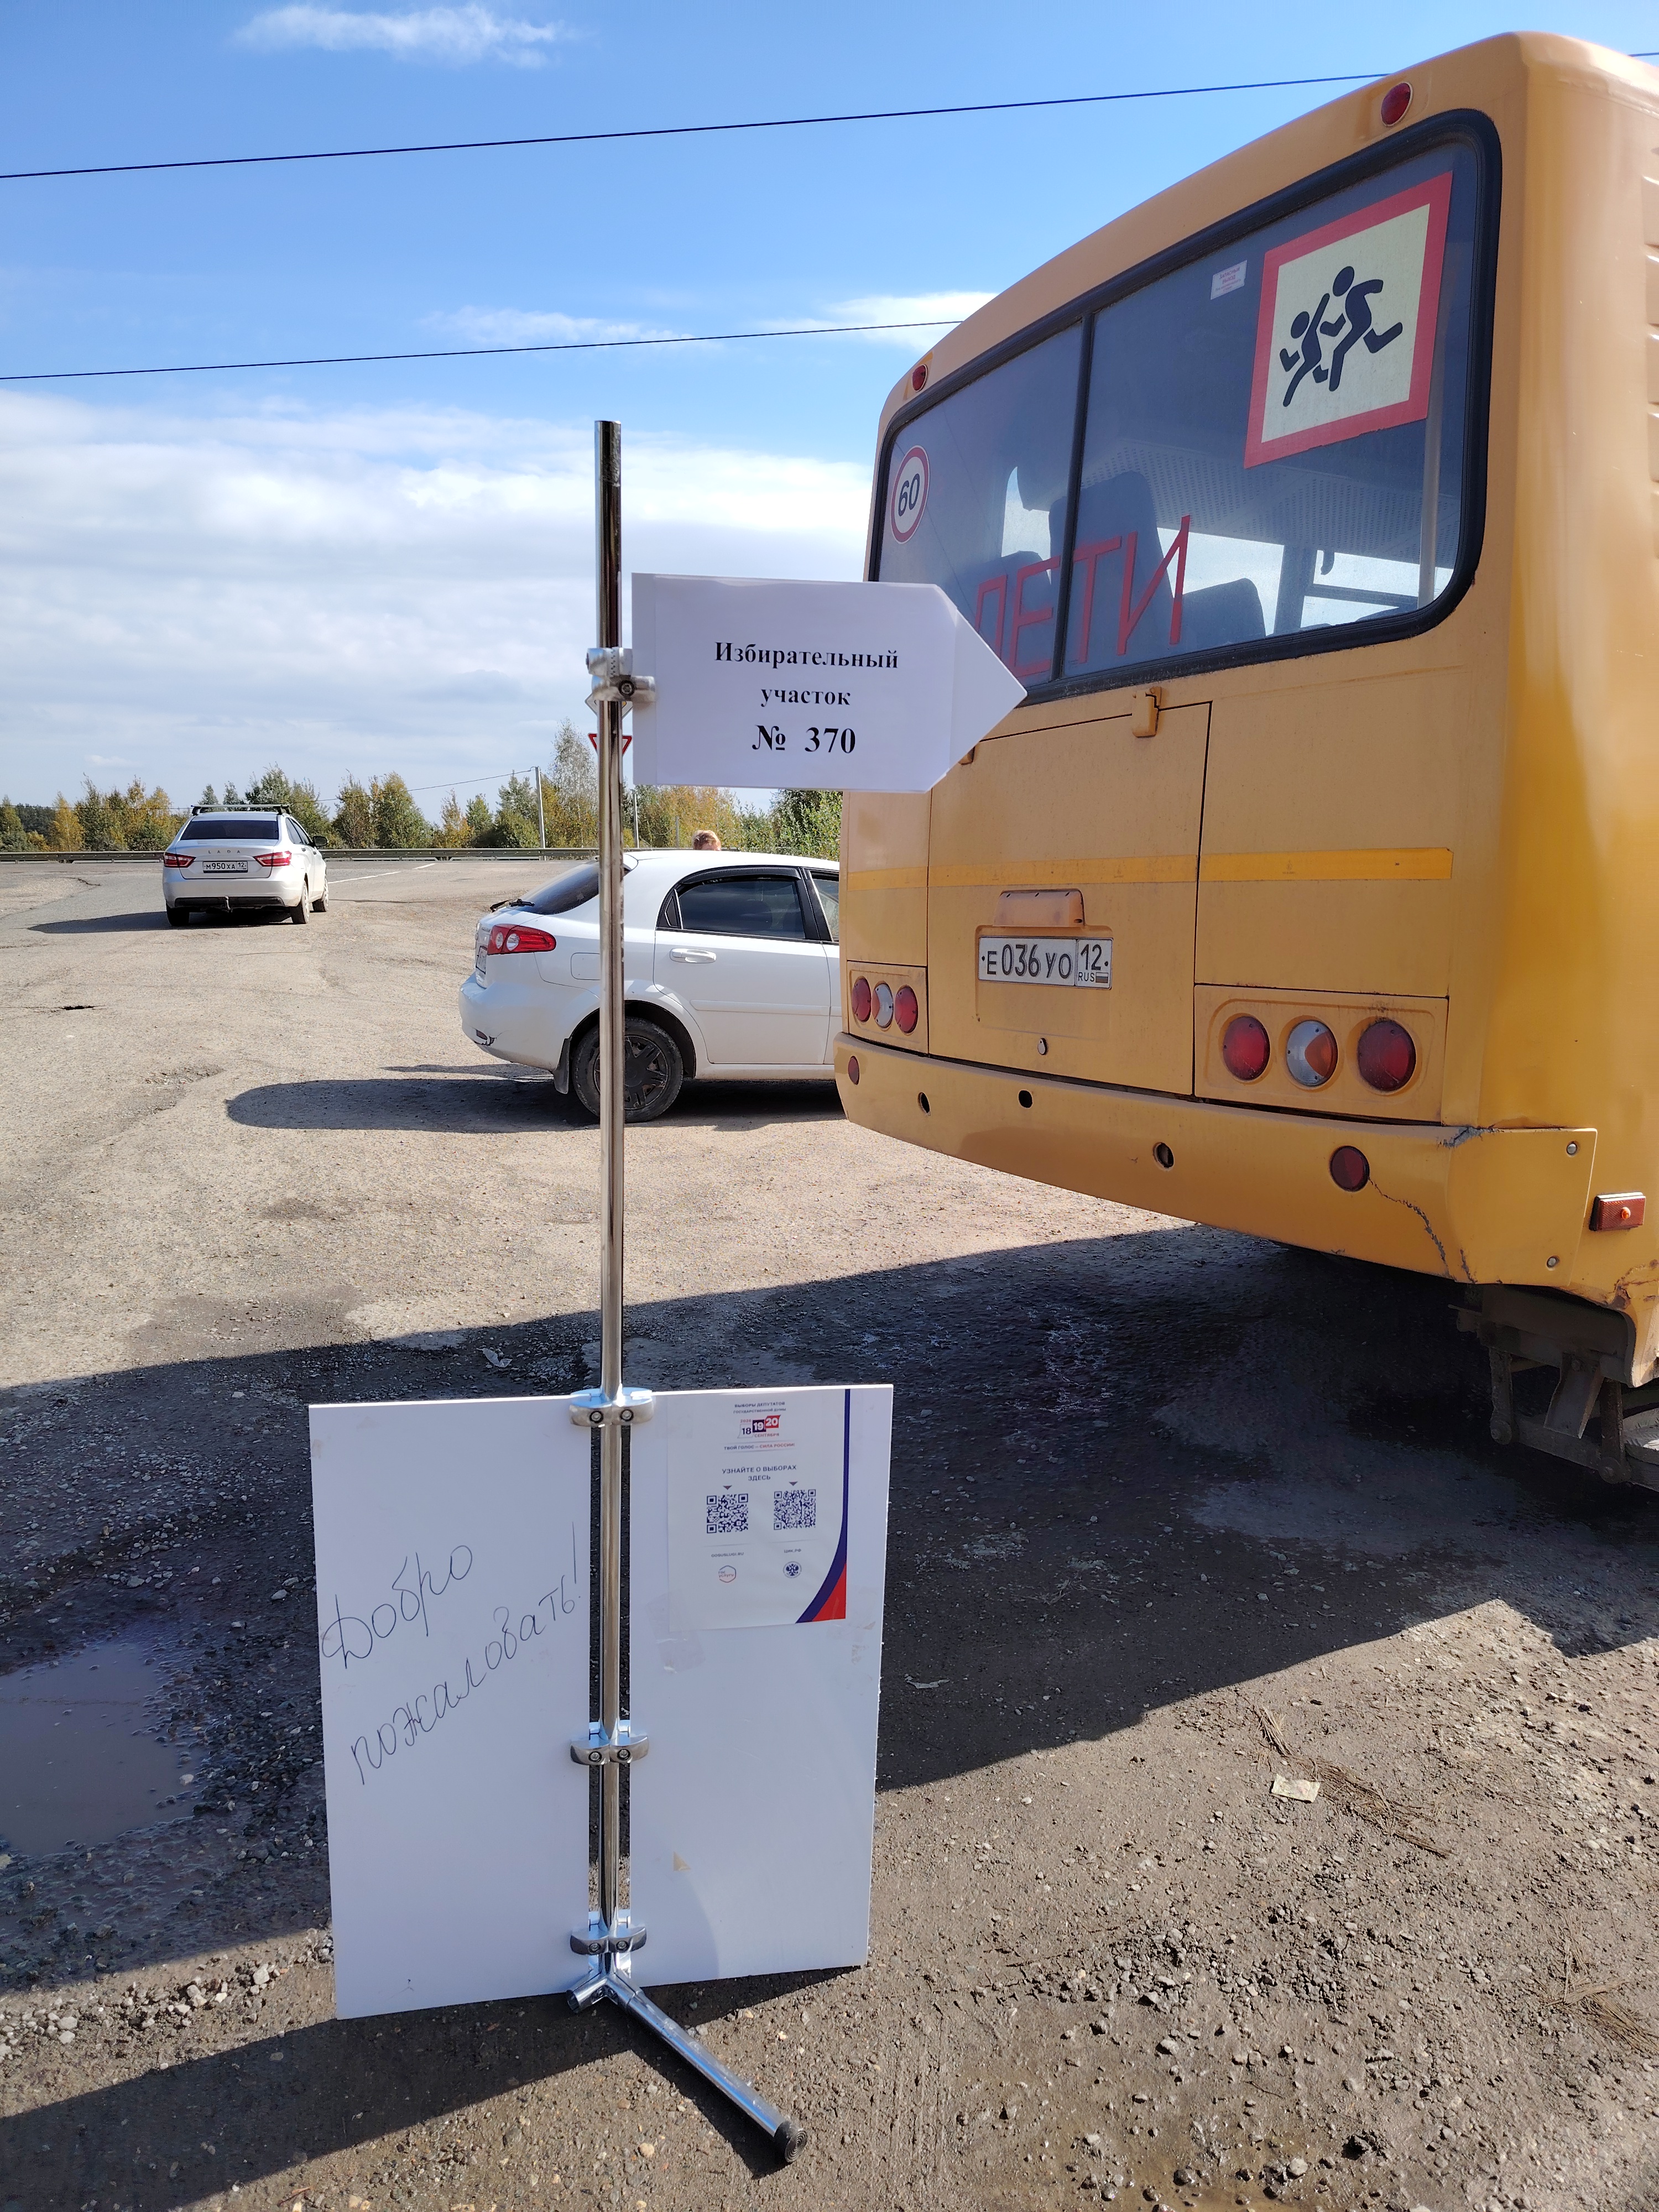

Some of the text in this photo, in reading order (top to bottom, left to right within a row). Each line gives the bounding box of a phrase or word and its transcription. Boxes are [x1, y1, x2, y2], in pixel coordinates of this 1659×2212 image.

[897, 473, 920, 517] 60
[714, 641, 899, 669] Избирательный
[761, 686, 851, 707] участок
[752, 724, 856, 754] № 370
[1080, 943, 1102, 971] 12
[1078, 972, 1095, 982] RUS
[753, 1422, 764, 1431] 19
[765, 1417, 779, 1427] 20
[722, 1466, 754, 1474] УЗНАЙТЕ
[322, 1545, 473, 1669] Добро
[351, 1521, 582, 1786] пожаловать!
